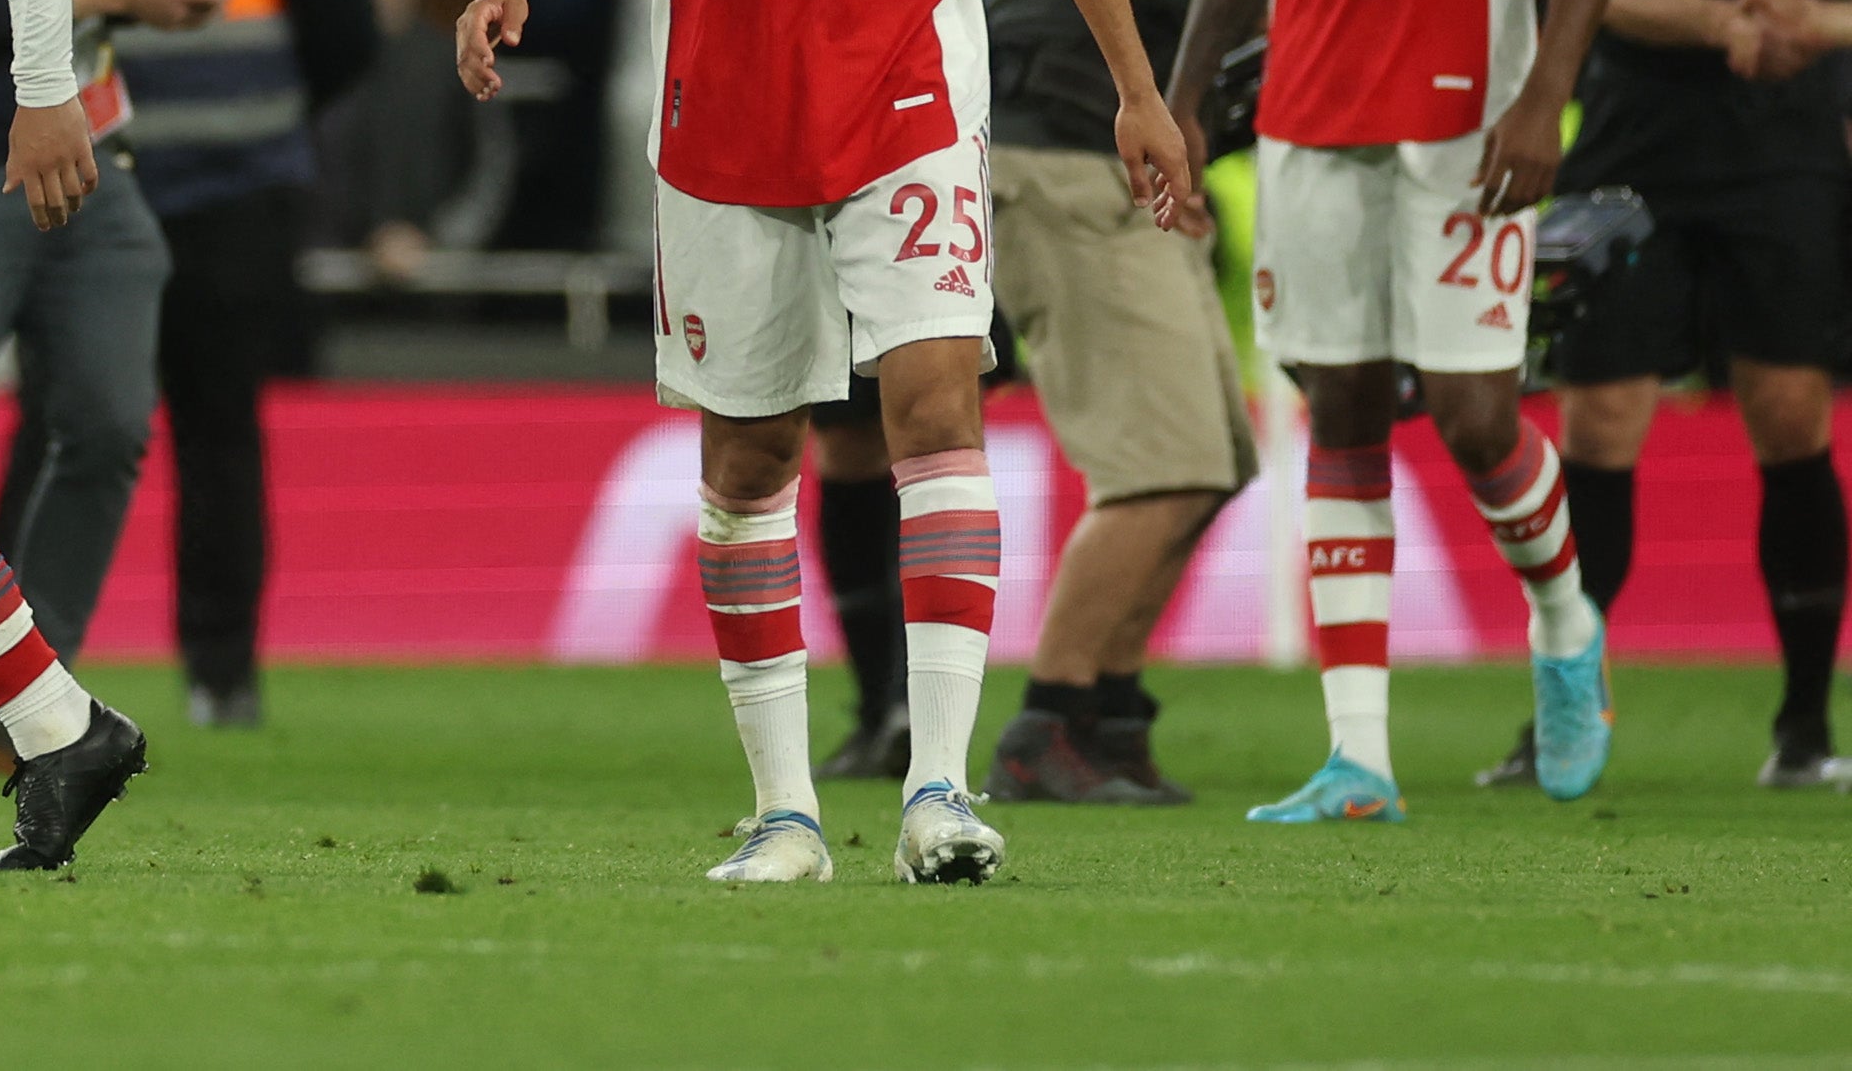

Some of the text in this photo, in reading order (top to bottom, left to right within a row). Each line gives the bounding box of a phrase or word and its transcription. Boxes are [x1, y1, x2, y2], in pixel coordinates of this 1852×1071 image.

[889, 183, 983, 263] 25
[1438, 212, 1526, 296] 20
[1310, 546, 1367, 568] AFC
